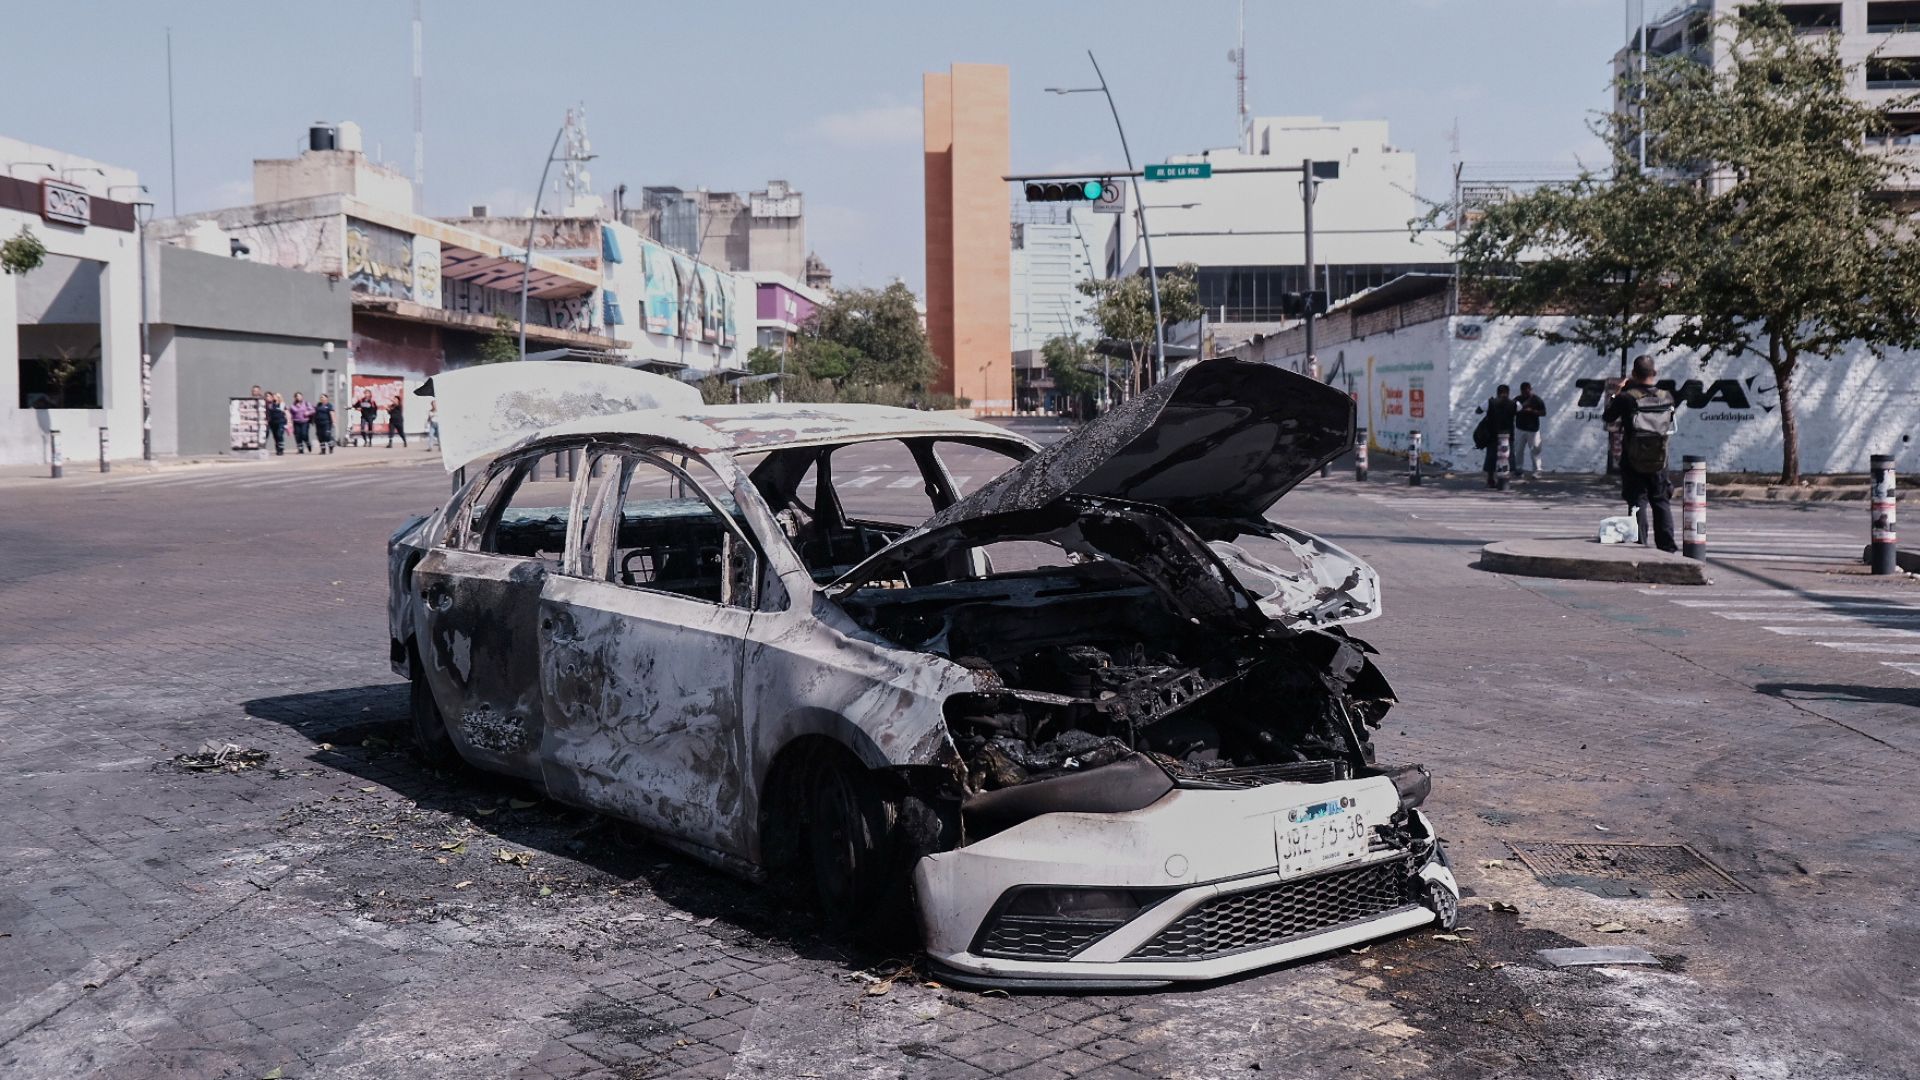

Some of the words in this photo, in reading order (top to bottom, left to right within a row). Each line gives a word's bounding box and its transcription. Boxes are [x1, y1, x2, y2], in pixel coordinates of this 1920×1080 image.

[1167, 168, 1176, 176] DE
[1178, 167, 1186, 176] LA
[1188, 167, 1199, 176] PAZ
[1700, 411, 1755, 422] Guadalajara
